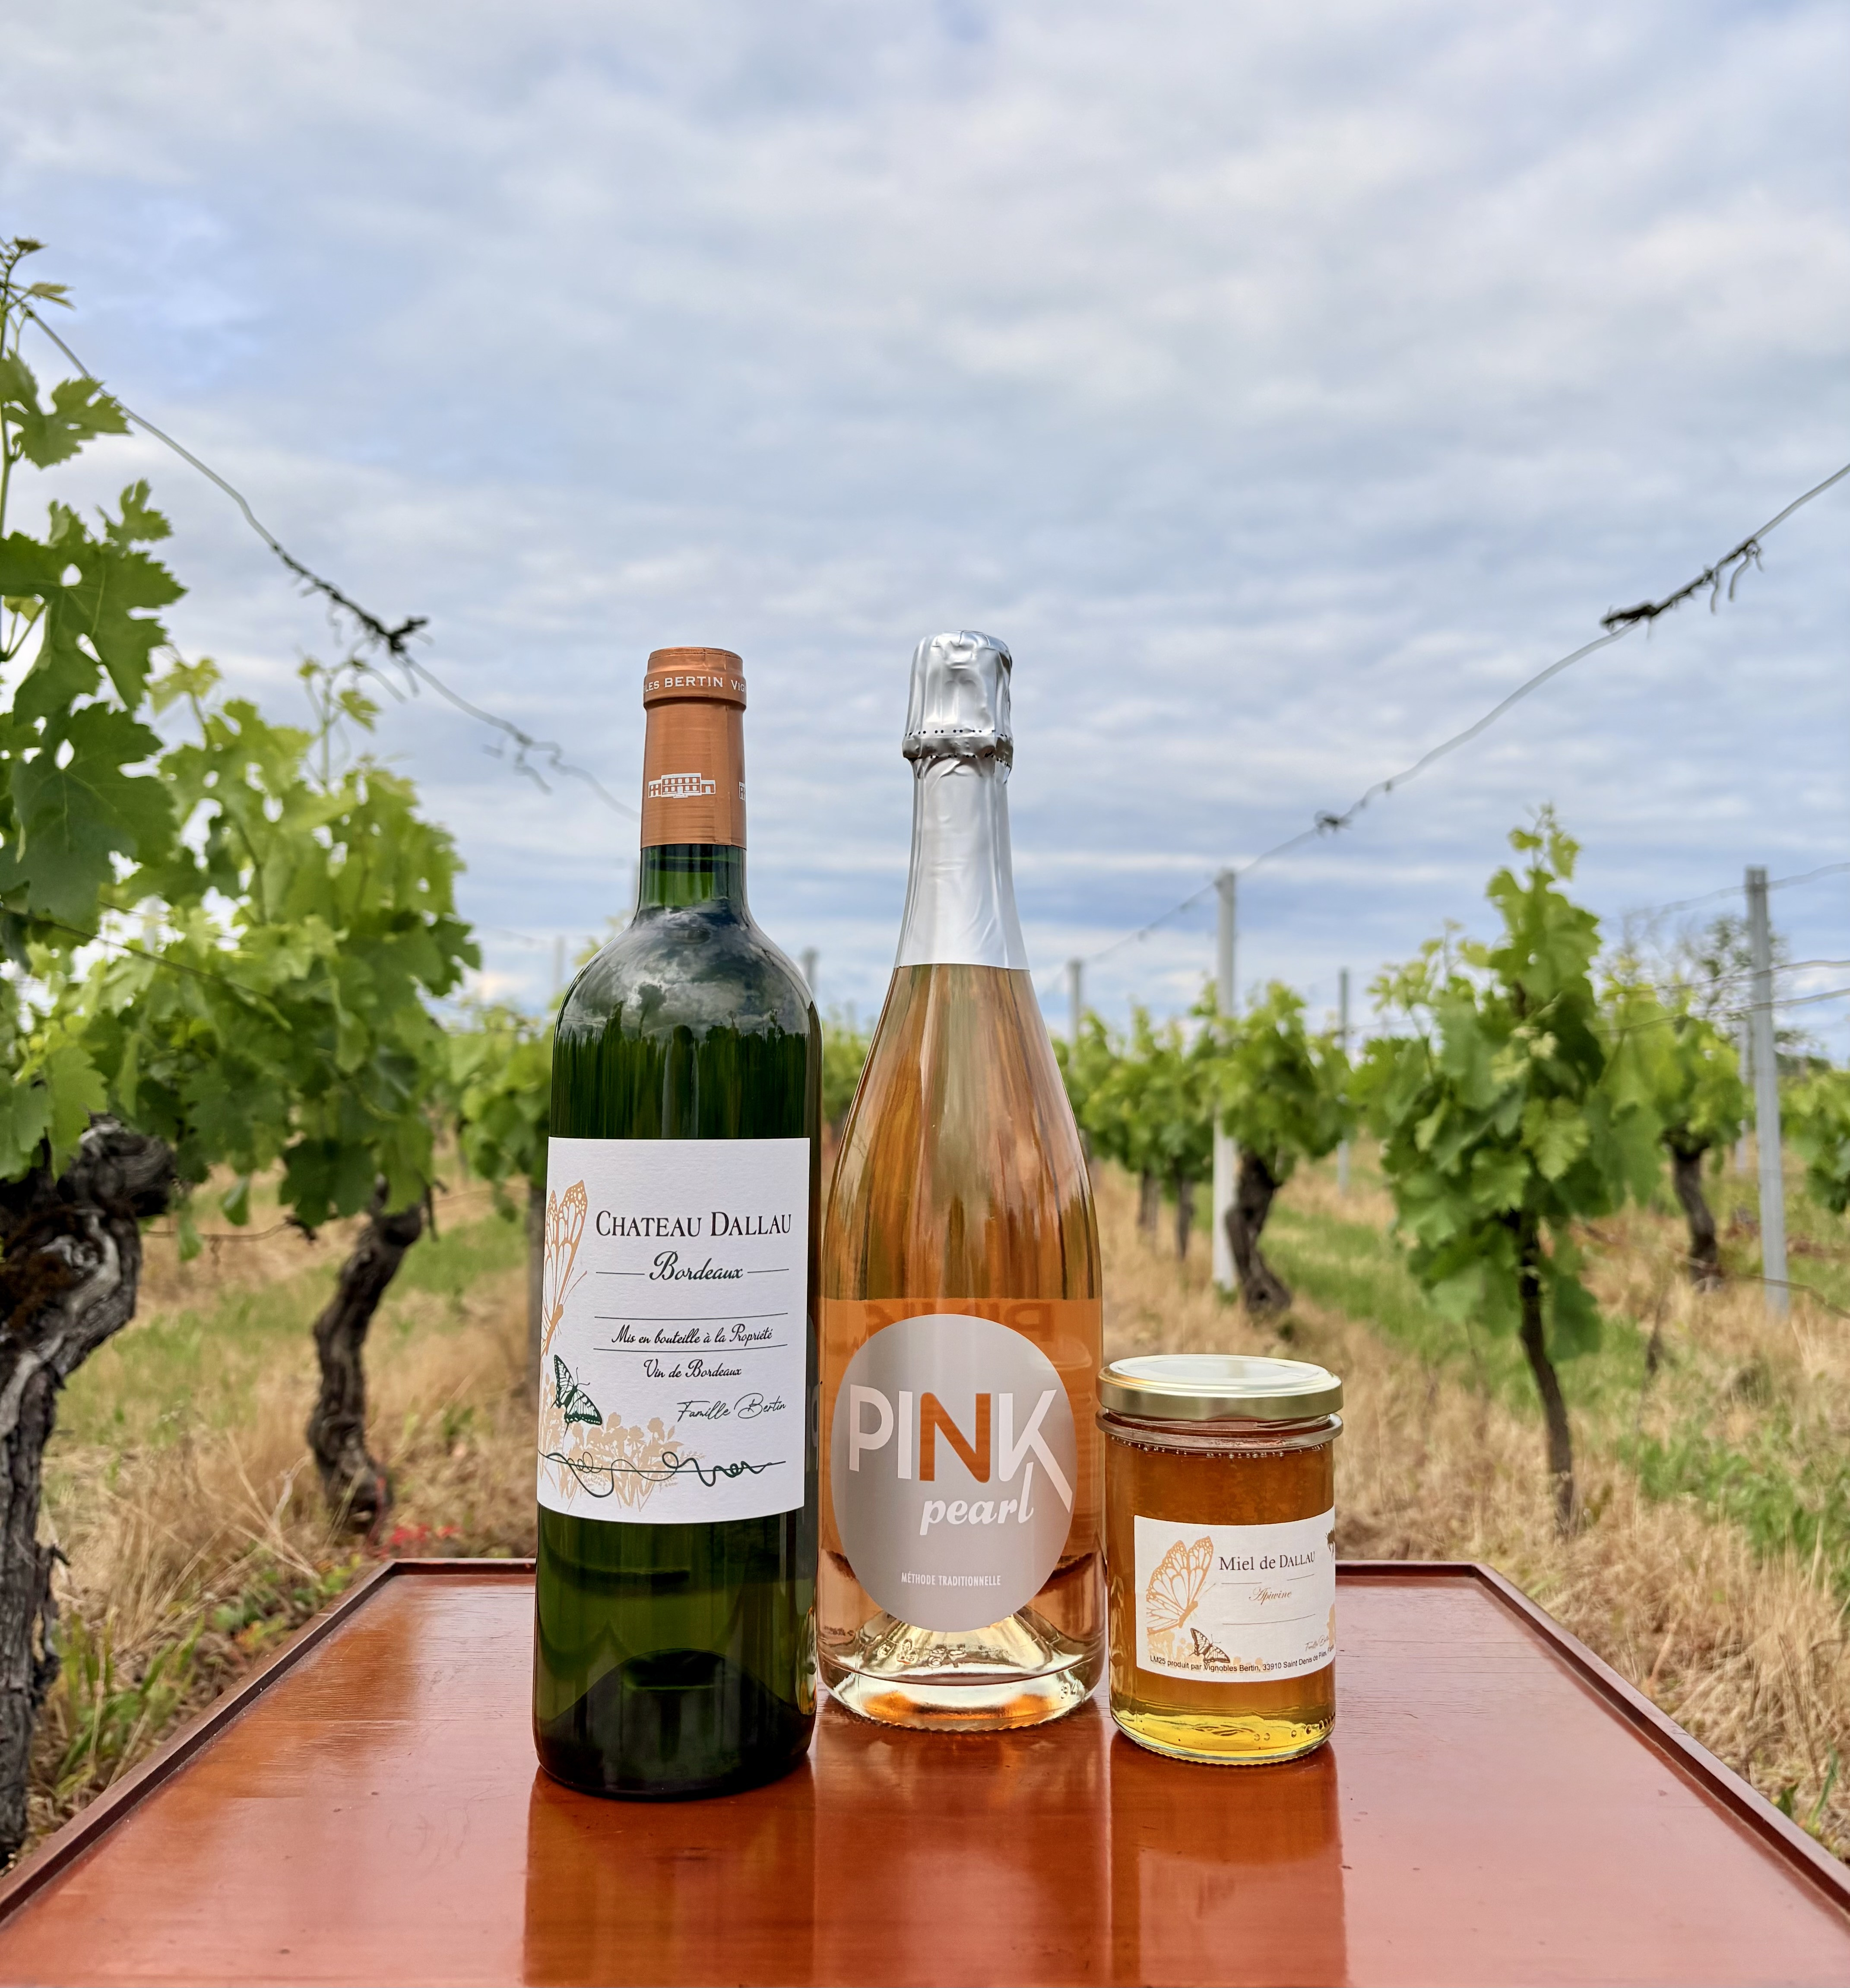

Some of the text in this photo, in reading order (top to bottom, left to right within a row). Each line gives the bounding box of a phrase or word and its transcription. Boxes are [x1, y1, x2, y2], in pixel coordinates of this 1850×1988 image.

[643, 676, 746, 693] LES BERTIN VIG
[596, 1211, 791, 1237] CHATEAU DALLAU
[649, 1251, 743, 1280] Bordeaux
[611, 1324, 636, 1343] Mis
[654, 1328, 700, 1344] bouteille
[704, 1332, 711, 1343] à
[715, 1327, 726, 1342] la
[729, 1323, 773, 1347] Propriété
[643, 1359, 741, 1378] Vin de Bordeaux
[677, 1393, 786, 1422] Famille Bertin
[849, 1384, 1073, 1513] PINK
[919, 1462, 1034, 1536] pearl
[1219, 1551, 1315, 1570] Miel de DALLAU
[901, 1571, 1001, 1587] MÉTHODE TRADITIONNELLE
[1249, 1587, 1292, 1605] Apiwine
[1150, 1655, 1166, 1665] LM25
[1168, 1660, 1189, 1669] produit
[1204, 1663, 1237, 1672] Vignobles
[1283, 1660, 1298, 1668] Saint
[1299, 1657, 1312, 1665] Denis
